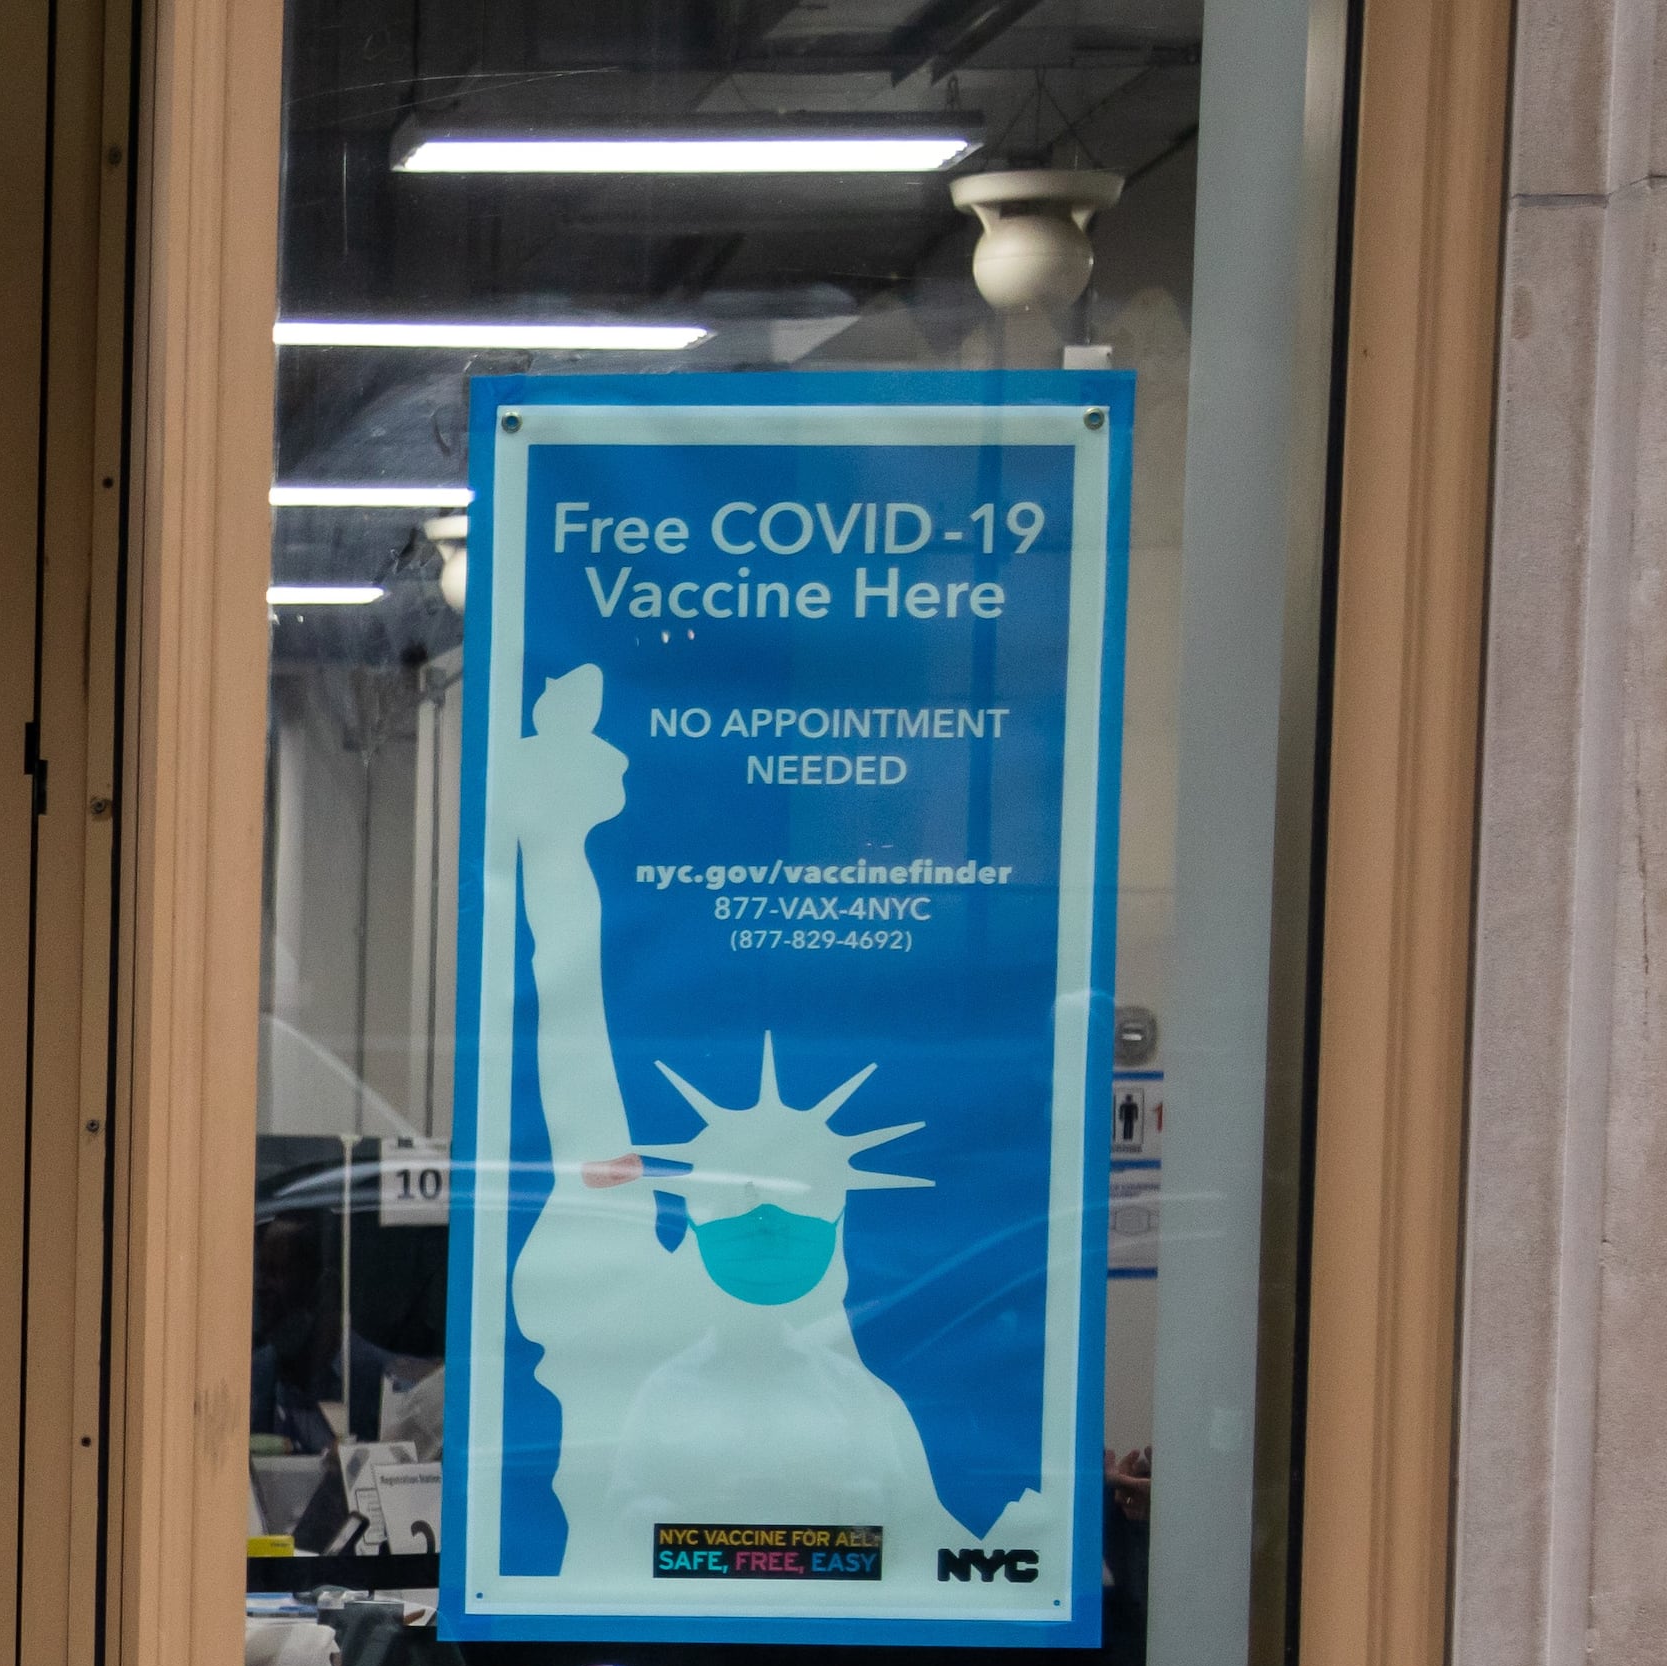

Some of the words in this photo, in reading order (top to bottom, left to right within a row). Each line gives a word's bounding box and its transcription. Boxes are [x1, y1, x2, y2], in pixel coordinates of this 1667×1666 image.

[553, 501, 689, 555] Free
[710, 500, 1046, 556] COVID-19
[584, 567, 832, 620] Vaccine
[854, 567, 1006, 620] Here
[649, 707, 712, 739] NO
[720, 707, 1011, 740] APPOINTMENT
[746, 755, 908, 786] NEEDED
[635, 858, 1013, 892] nyc.gov/vaccinefinder
[713, 896, 932, 923] 877-VAX-4NYC
[729, 929, 914, 953] (877-829-4692)
[395, 1168, 443, 1200] 10
[659, 1529, 698, 1546] NYC
[703, 1529, 787, 1547] VACCINE
[791, 1530, 829, 1547] FOR
[659, 1550, 728, 1574] SAFE,
[735, 1551, 804, 1575] FREE,
[812, 1552, 876, 1574] EASY
[937, 1548, 1039, 1583] NYC
